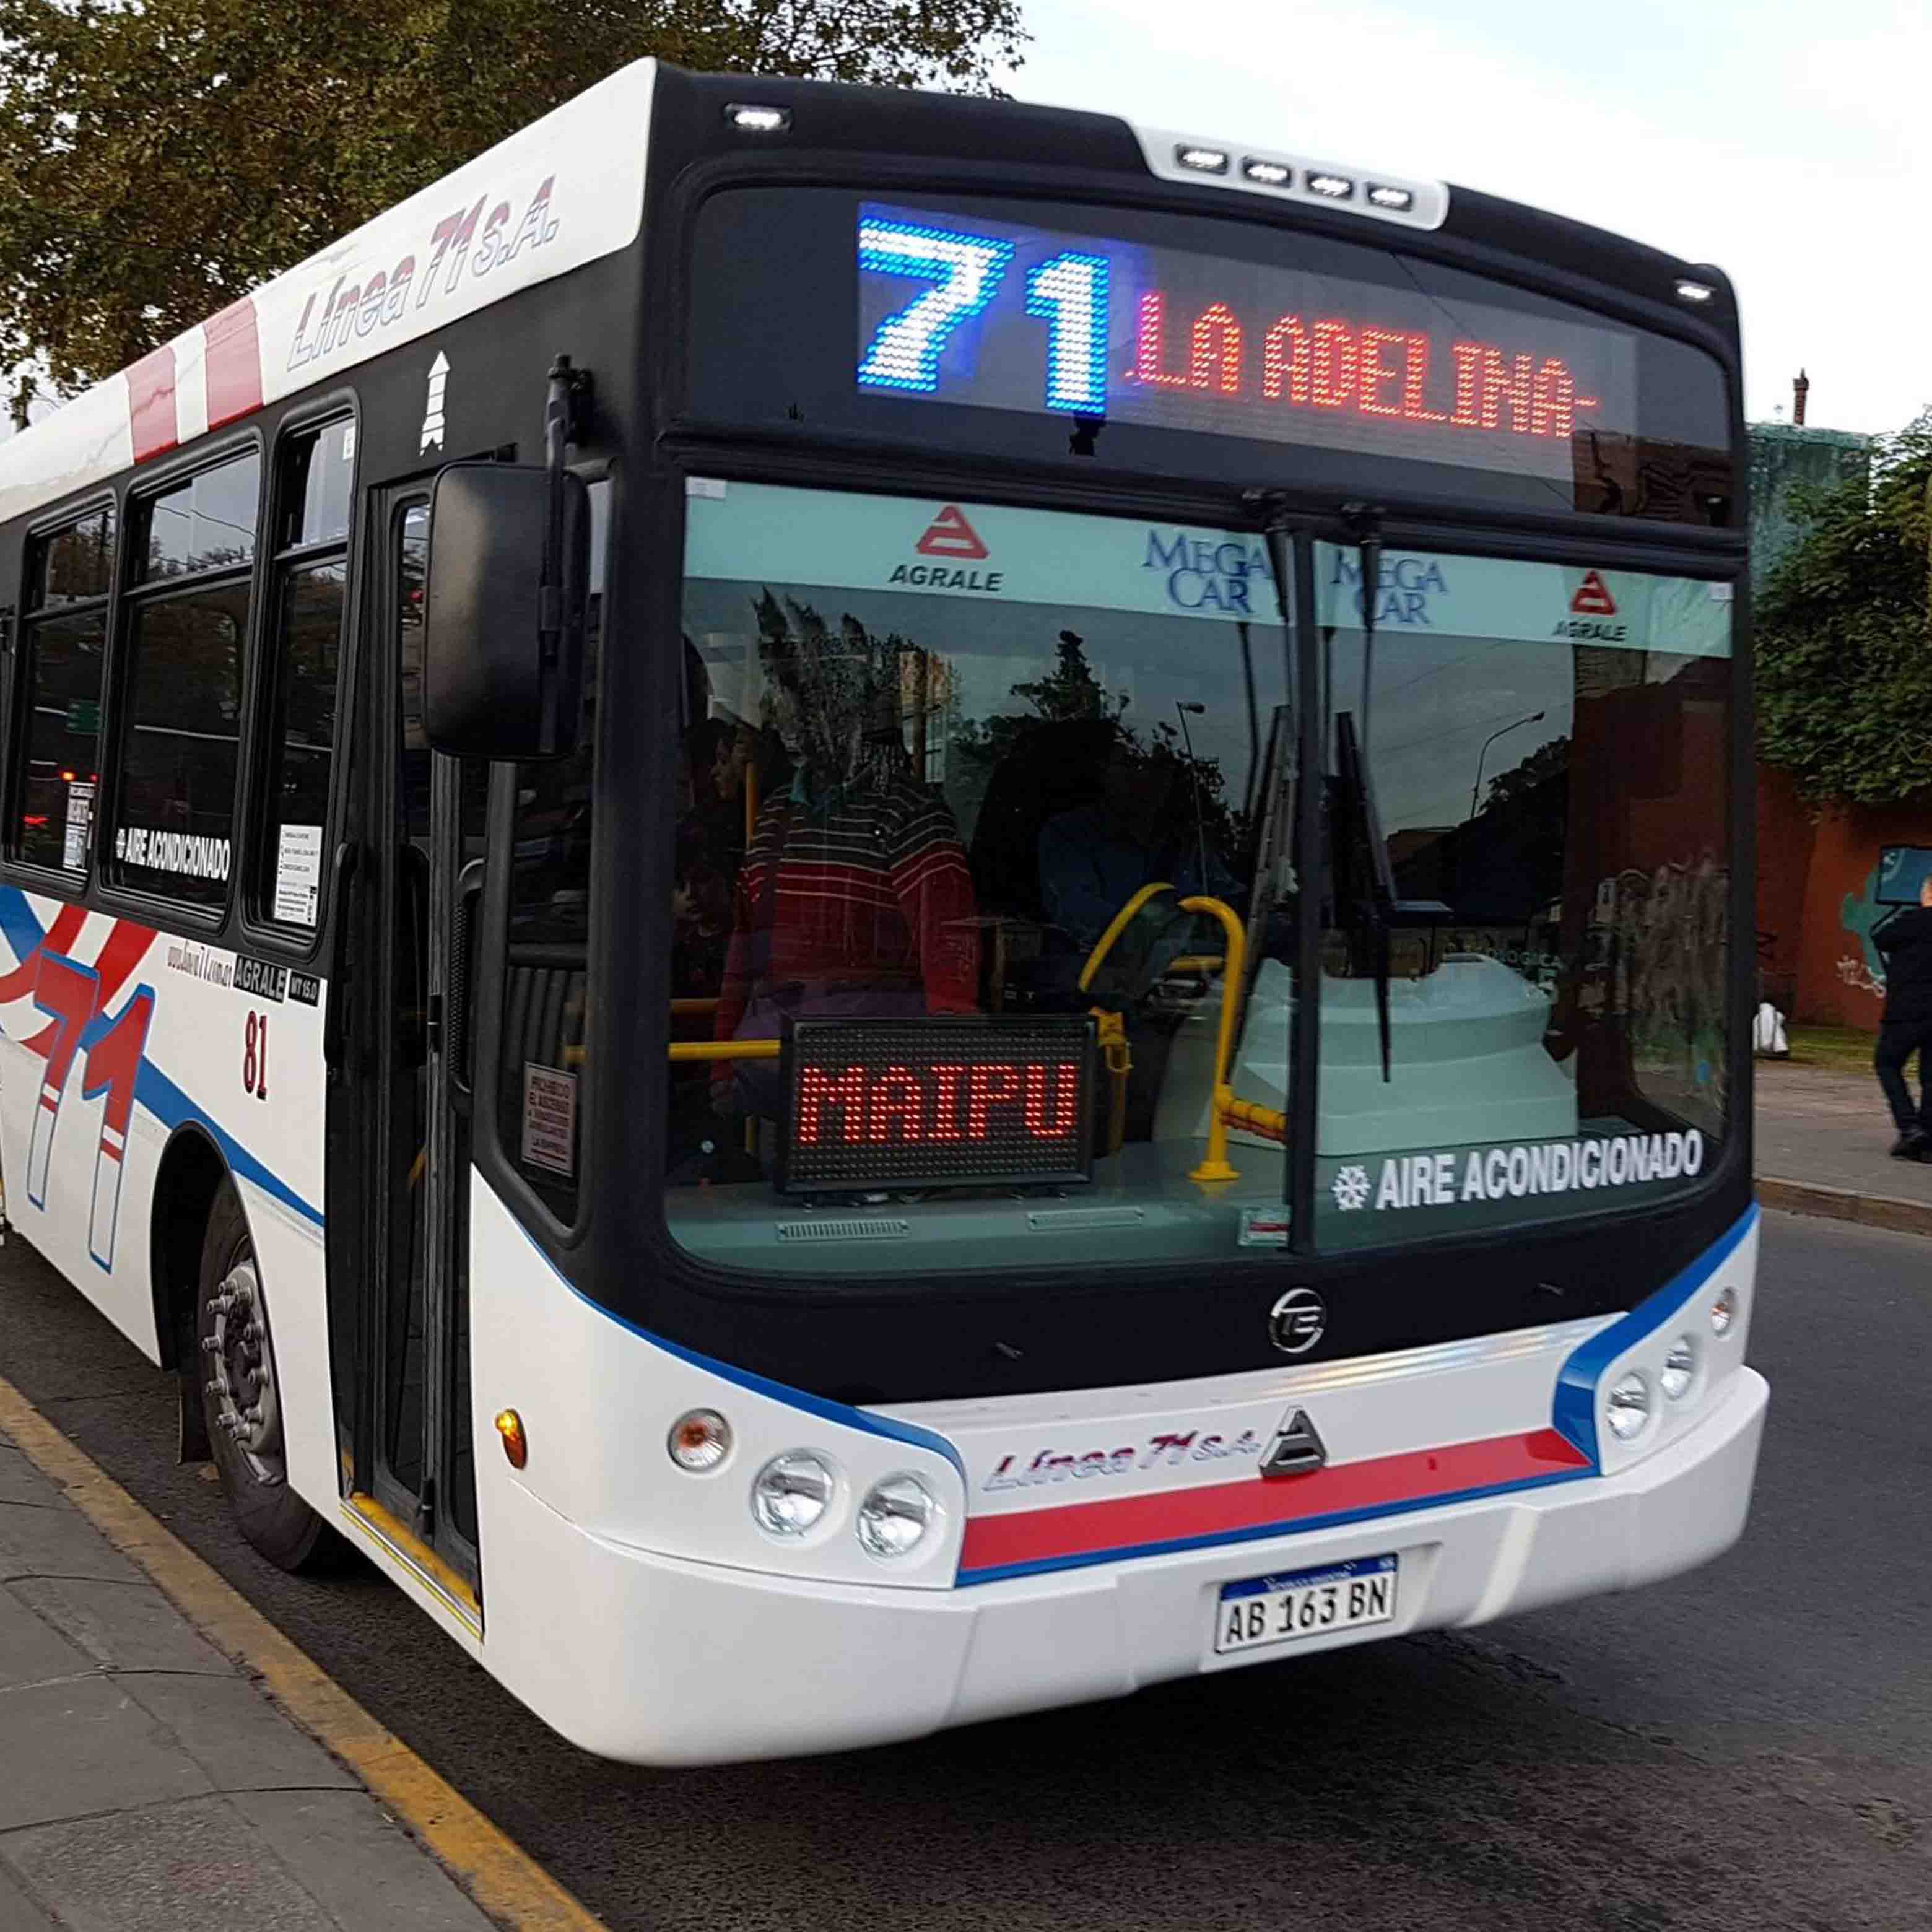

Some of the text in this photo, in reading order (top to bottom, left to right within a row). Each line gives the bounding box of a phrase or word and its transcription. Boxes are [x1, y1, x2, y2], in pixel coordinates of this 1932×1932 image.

[417, 194, 488, 309] 71
[856, 214, 1111, 415] 71
[887, 564, 1003, 593] AGRALE
[1142, 529, 1273, 580] MEGA
[1168, 568, 1255, 614] CAR
[125, 827, 147, 866] AIRE
[146, 830, 230, 881] ACONDICIONADO
[235, 958, 286, 999] AGRALE
[244, 1009, 268, 1101] 81
[798, 1064, 1076, 1143] MAIPU
[1375, 1130, 1703, 1210] AIRE ACONDICIONADO
[1227, 1577, 1388, 1643] AB 163 BN
